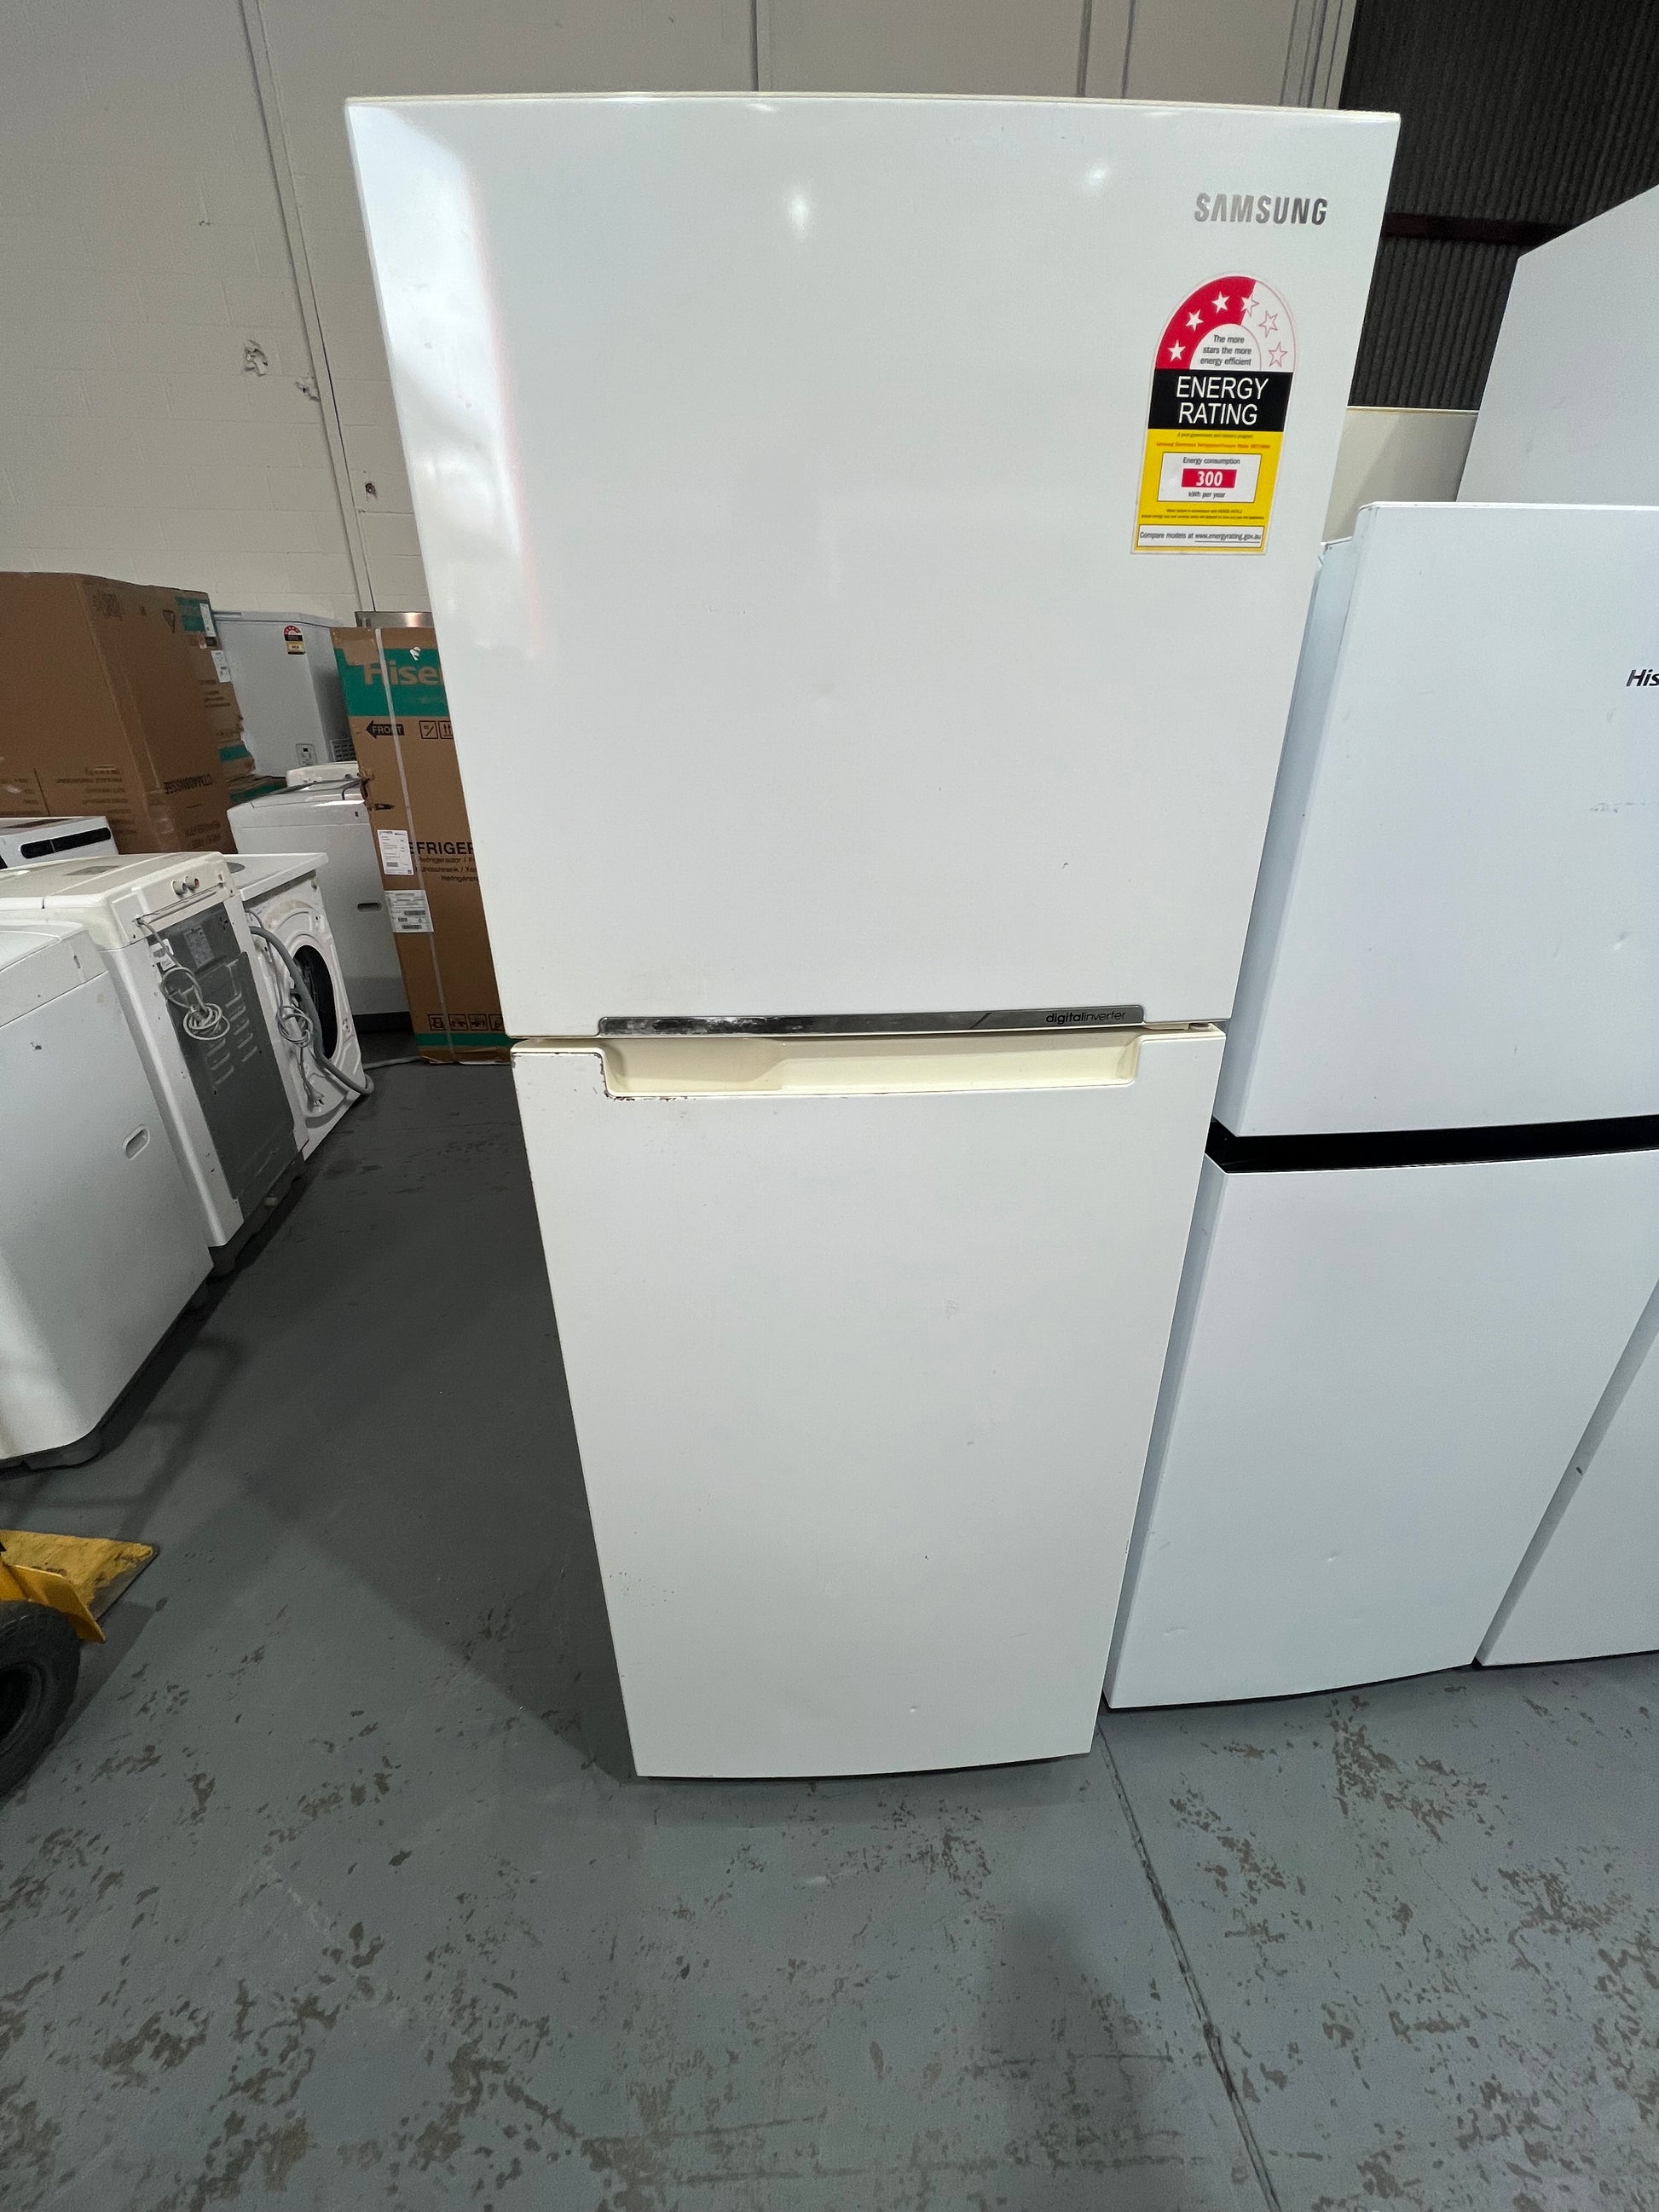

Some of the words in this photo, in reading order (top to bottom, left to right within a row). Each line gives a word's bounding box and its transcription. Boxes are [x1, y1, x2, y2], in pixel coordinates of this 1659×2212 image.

[1194, 193, 1328, 226] SAMSUNG
[1213, 334, 1226, 343] The
[1202, 346, 1220, 355] stars
[1221, 346, 1233, 355] the
[1199, 358, 1223, 367] energy
[1224, 357, 1252, 367] efficient
[1176, 375, 1269, 400] ENERGY
[1178, 401, 1258, 425] RATING
[1182, 456, 1203, 465] Energy
[1204, 457, 1241, 465] consumption
[1195, 471, 1223, 487] 300
[1139, 531, 1165, 540] Compare
[363, 660, 443, 686] Hise
[372, 725, 403, 735] FROT
